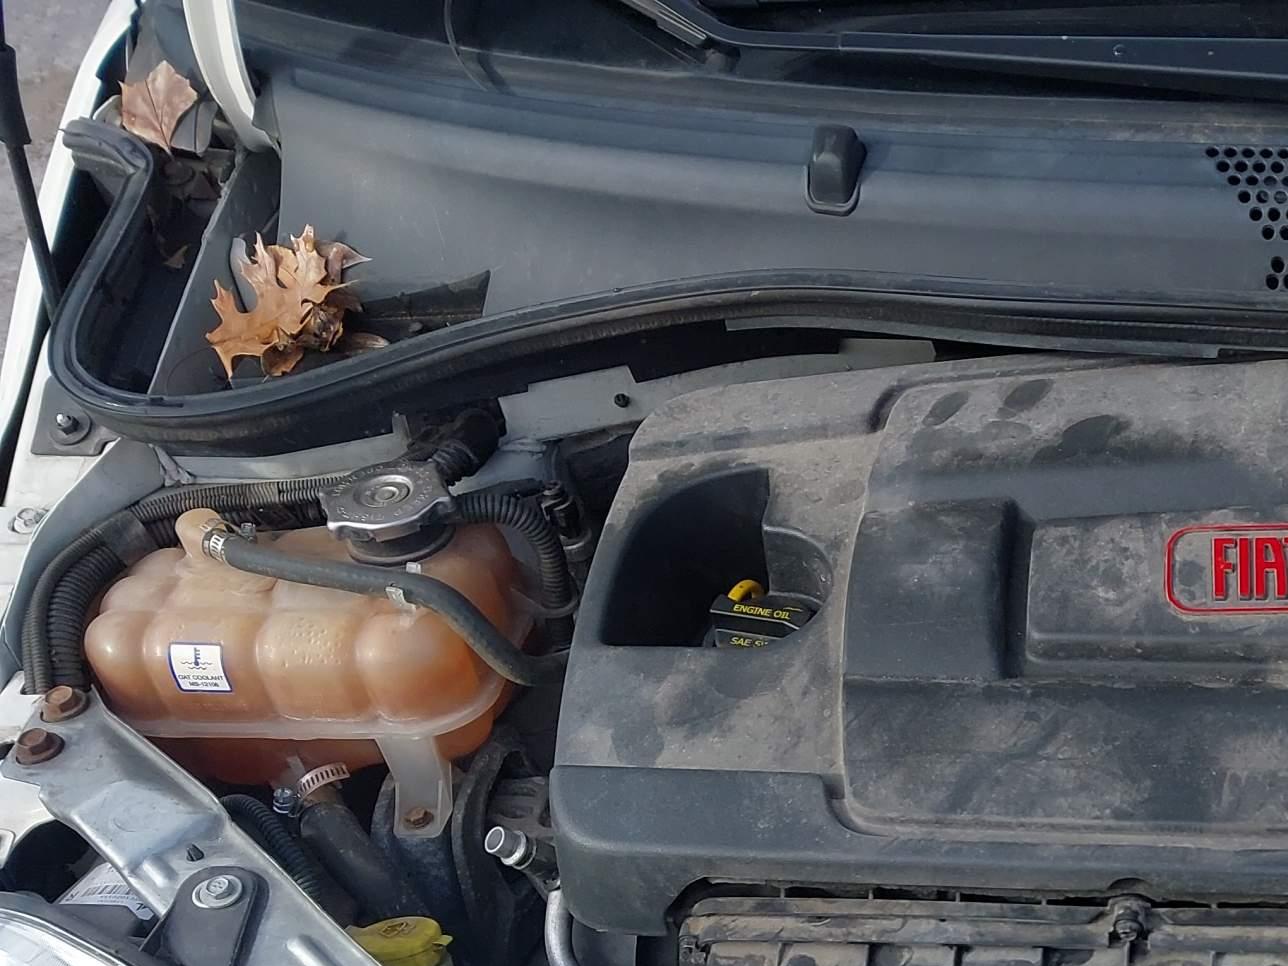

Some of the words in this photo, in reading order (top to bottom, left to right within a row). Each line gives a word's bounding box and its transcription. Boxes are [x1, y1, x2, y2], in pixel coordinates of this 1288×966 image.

[733, 604, 772, 617] ENGINE
[773, 610, 791, 620] OIL
[730, 636, 752, 647] SAE
